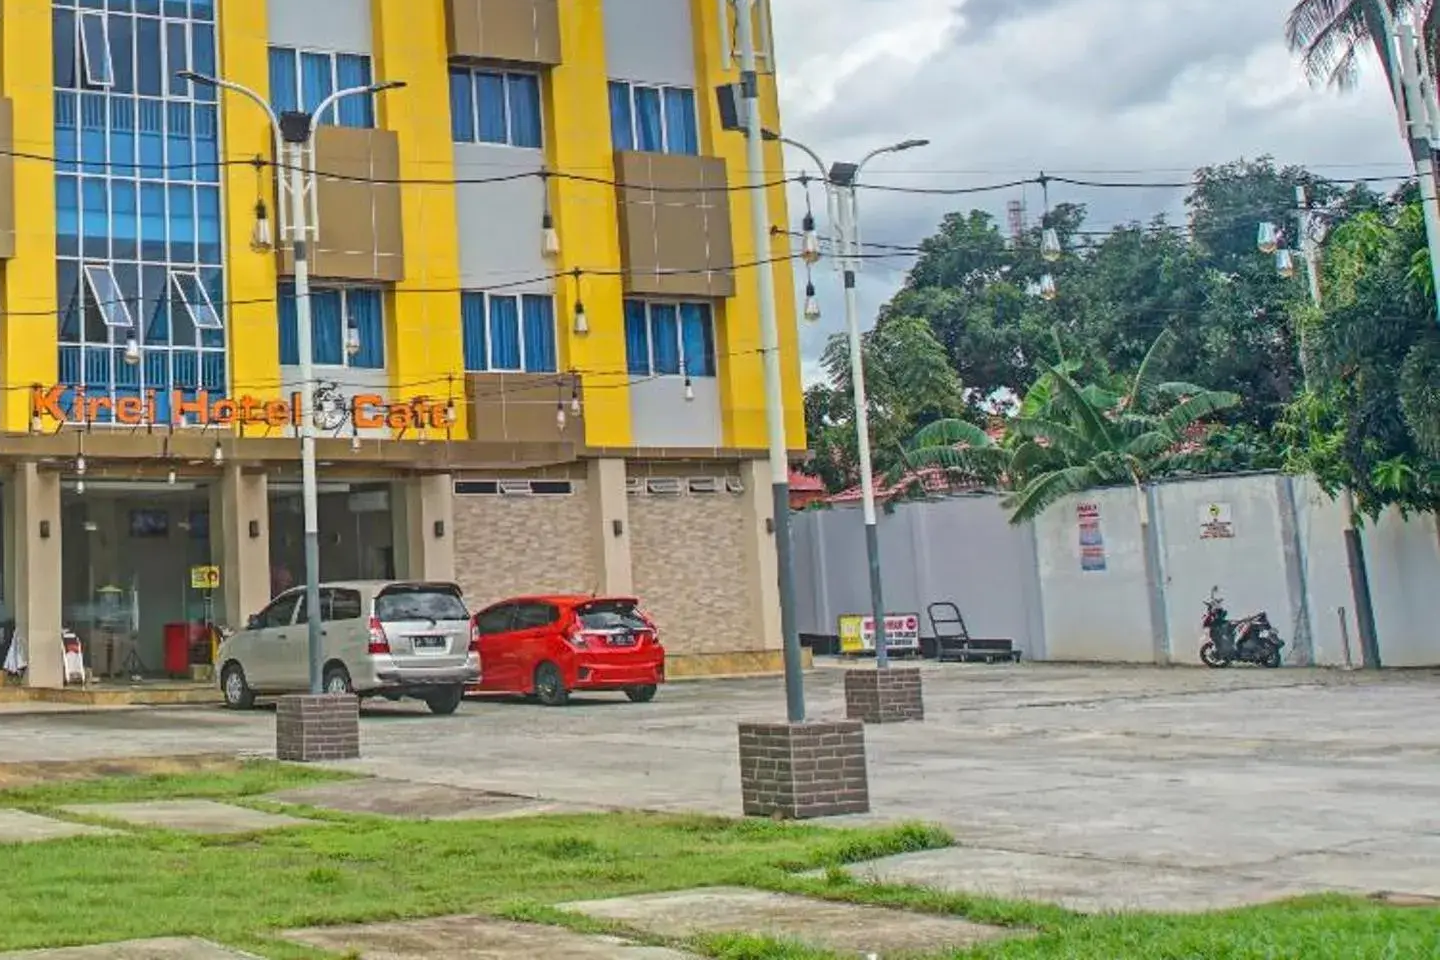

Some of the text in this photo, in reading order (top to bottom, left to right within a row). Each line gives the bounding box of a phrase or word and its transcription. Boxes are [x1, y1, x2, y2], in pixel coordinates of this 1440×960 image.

[33, 384, 157, 424] Kirei
[171, 389, 302, 427] Hotel
[352, 394, 453, 429] Cafe
